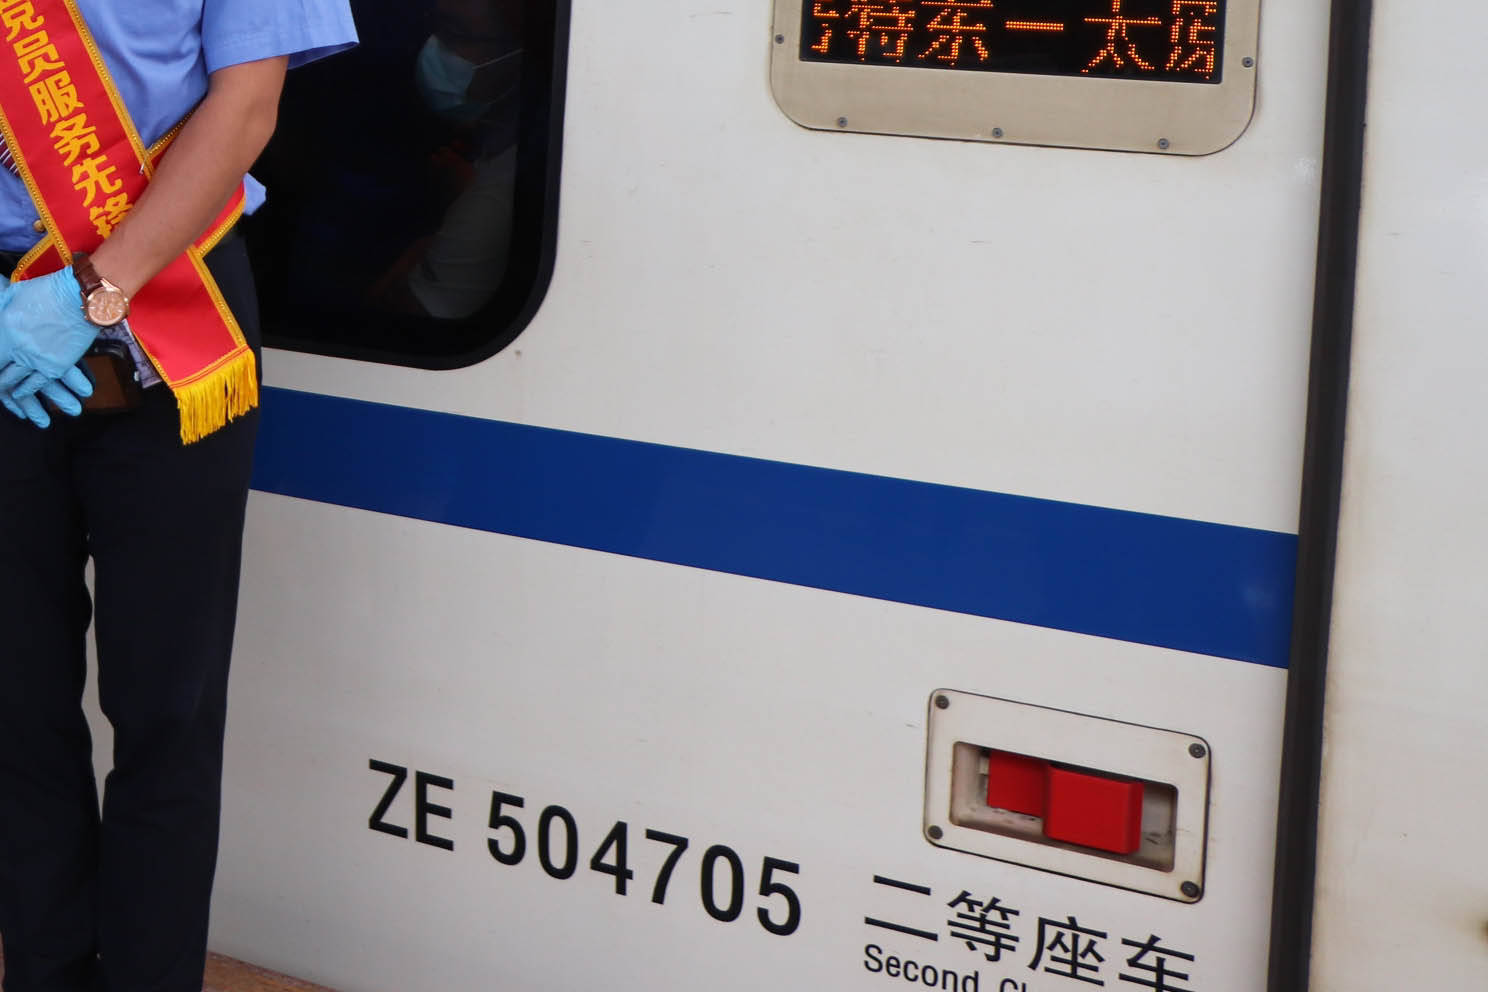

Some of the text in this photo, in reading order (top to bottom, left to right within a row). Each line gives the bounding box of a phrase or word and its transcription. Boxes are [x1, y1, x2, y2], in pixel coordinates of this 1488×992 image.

[369, 758, 802, 937] ZE 504705
[864, 874, 1196, 992] 二等座车
[864, 943, 980, 992] Second
